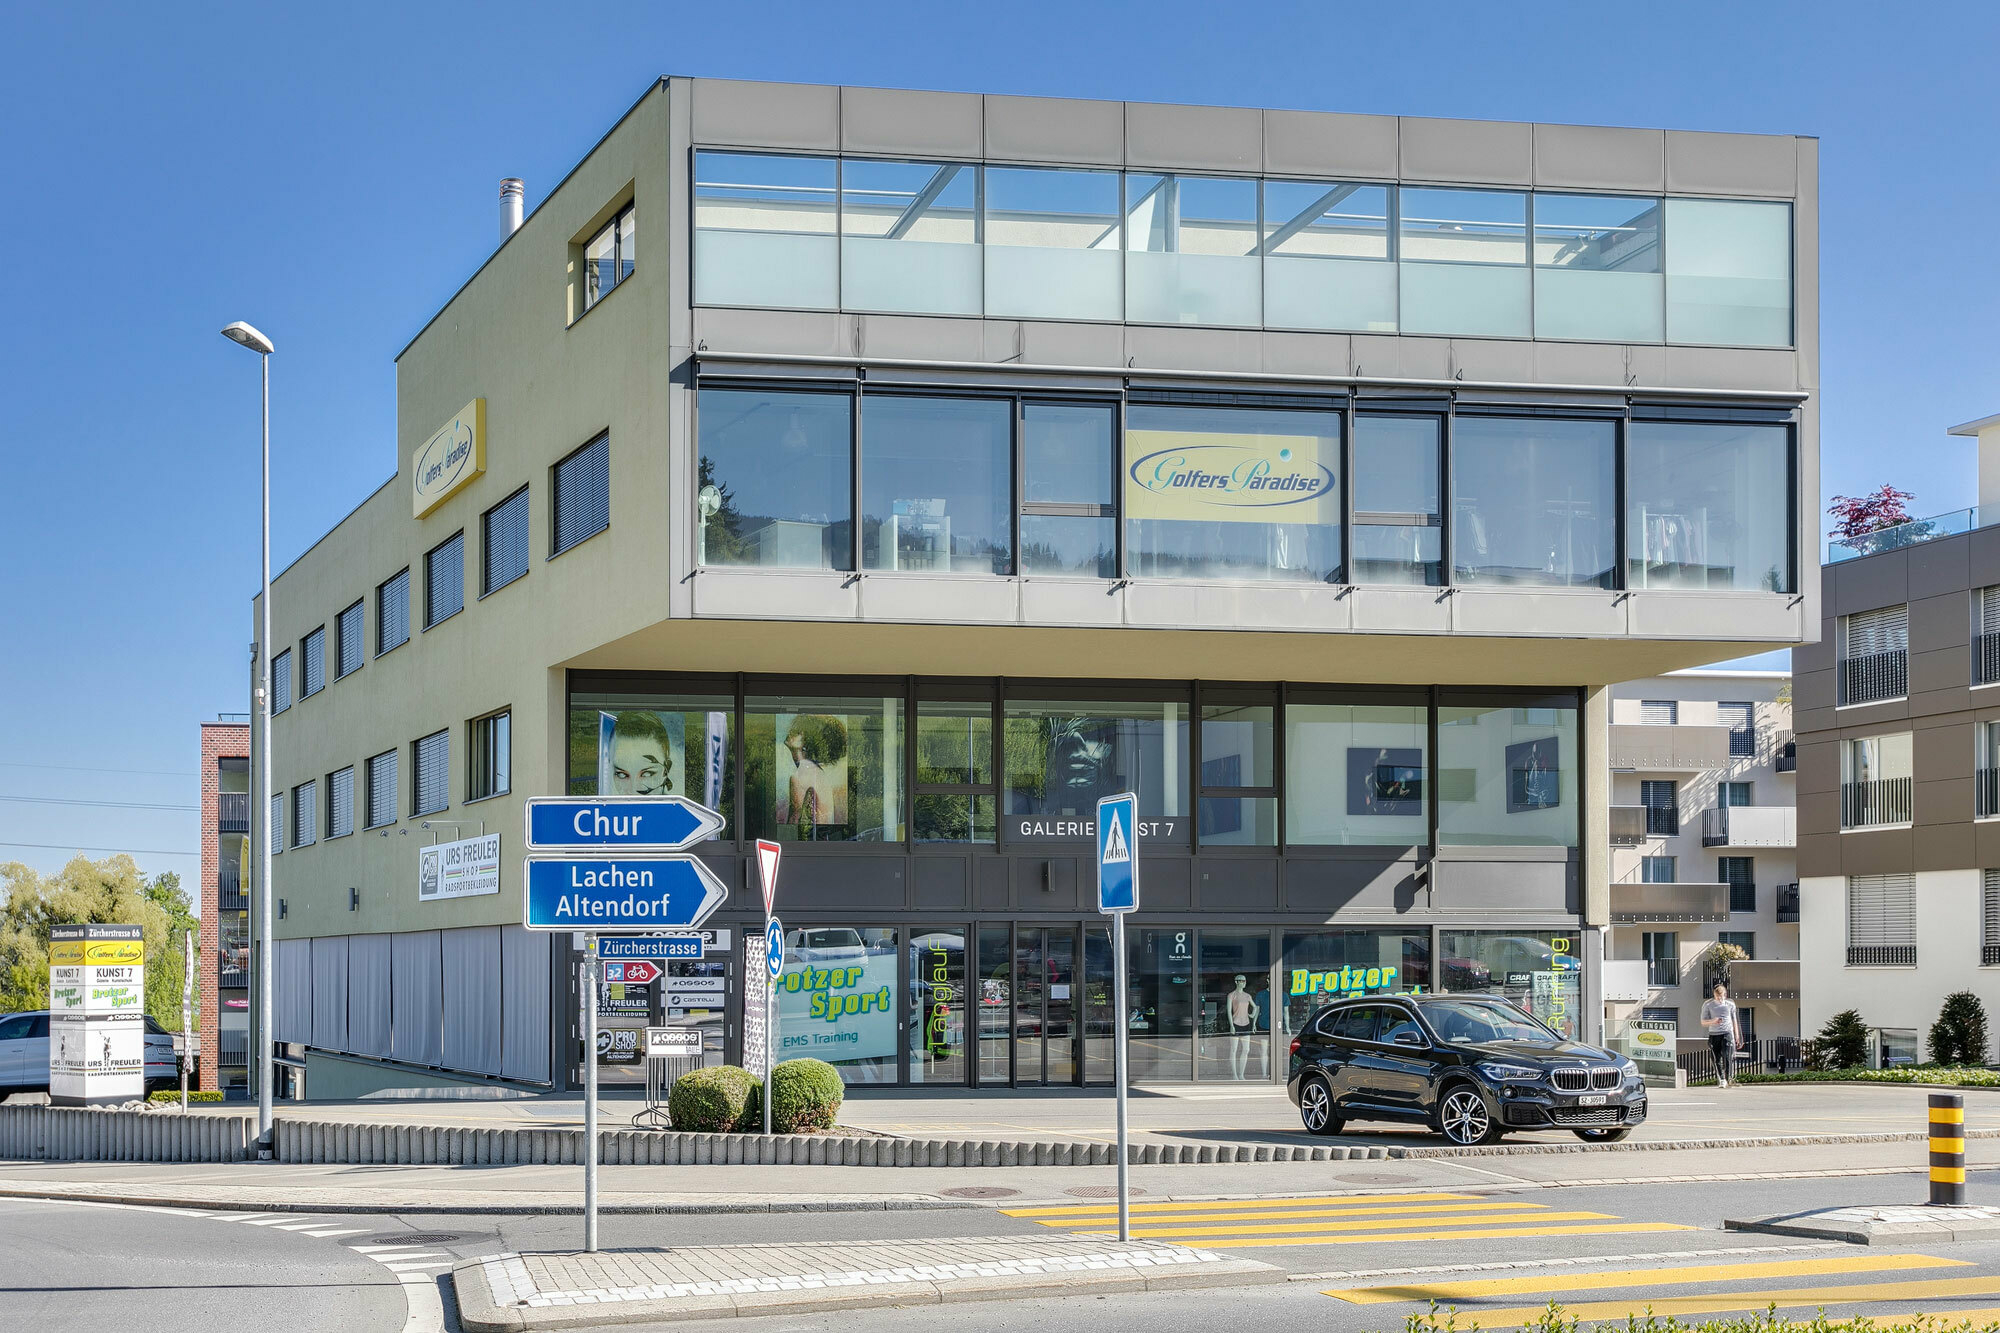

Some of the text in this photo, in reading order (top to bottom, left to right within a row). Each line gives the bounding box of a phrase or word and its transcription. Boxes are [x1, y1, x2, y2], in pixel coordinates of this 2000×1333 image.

[1148, 456, 1321, 496] Golfers Paradise
[573, 808, 643, 837] Chur
[1020, 821, 1095, 836] GALERIE
[1165, 822, 1174, 837] 7
[446, 847, 461, 866] URS
[463, 840, 498, 863] FREULER
[463, 865, 479, 877] SHOP
[572, 864, 654, 888] Lachen
[555, 893, 671, 917] Altendorf
[88, 928, 140, 938] Zürcherstrasse 66
[603, 940, 698, 955] Zürcherstrasse
[56, 968, 80, 978] KUNST 7
[96, 968, 133, 977] KUNST 7
[607, 967, 622, 979] 32
[774, 965, 863, 994] rotzer
[1290, 965, 1398, 996] Brotzer
[1547, 938, 1570, 1030] Running
[92, 987, 129, 999] Brotzer
[928, 936, 952, 1045] Langlauf
[111, 994, 137, 1007] Sport
[610, 999, 648, 1007] FREULER
[810, 986, 891, 1022] Sport
[1641, 1022, 1674, 1030] EINGANG
[615, 1031, 637, 1042] PRO
[783, 1031, 859, 1047] EMS Training
[615, 1040, 637, 1050] SHOP
[110, 1059, 141, 1067] FREULER
